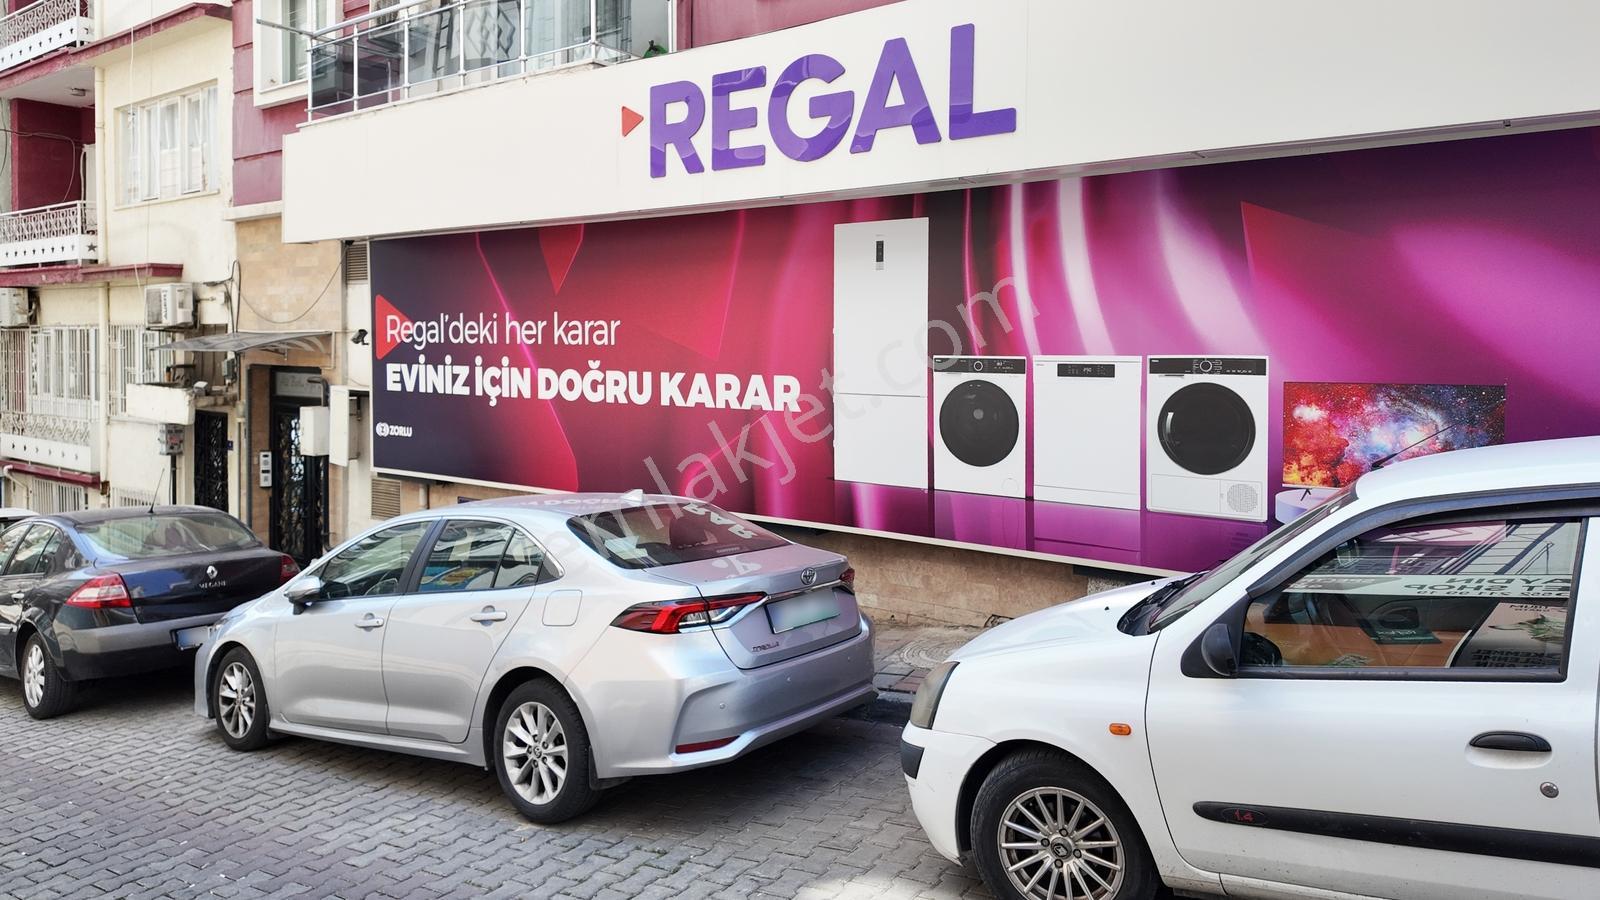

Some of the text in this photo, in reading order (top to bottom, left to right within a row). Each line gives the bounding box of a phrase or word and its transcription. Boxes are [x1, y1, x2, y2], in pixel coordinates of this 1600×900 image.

[650, 23, 1017, 178] REGAL
[386, 312, 620, 350] Regal'deki her karar
[386, 355, 802, 412] EVİNİZ İÇİN DOĞRU KARAR
[389, 424, 413, 437] ZORLU
[1233, 808, 1254, 823] 1.4
